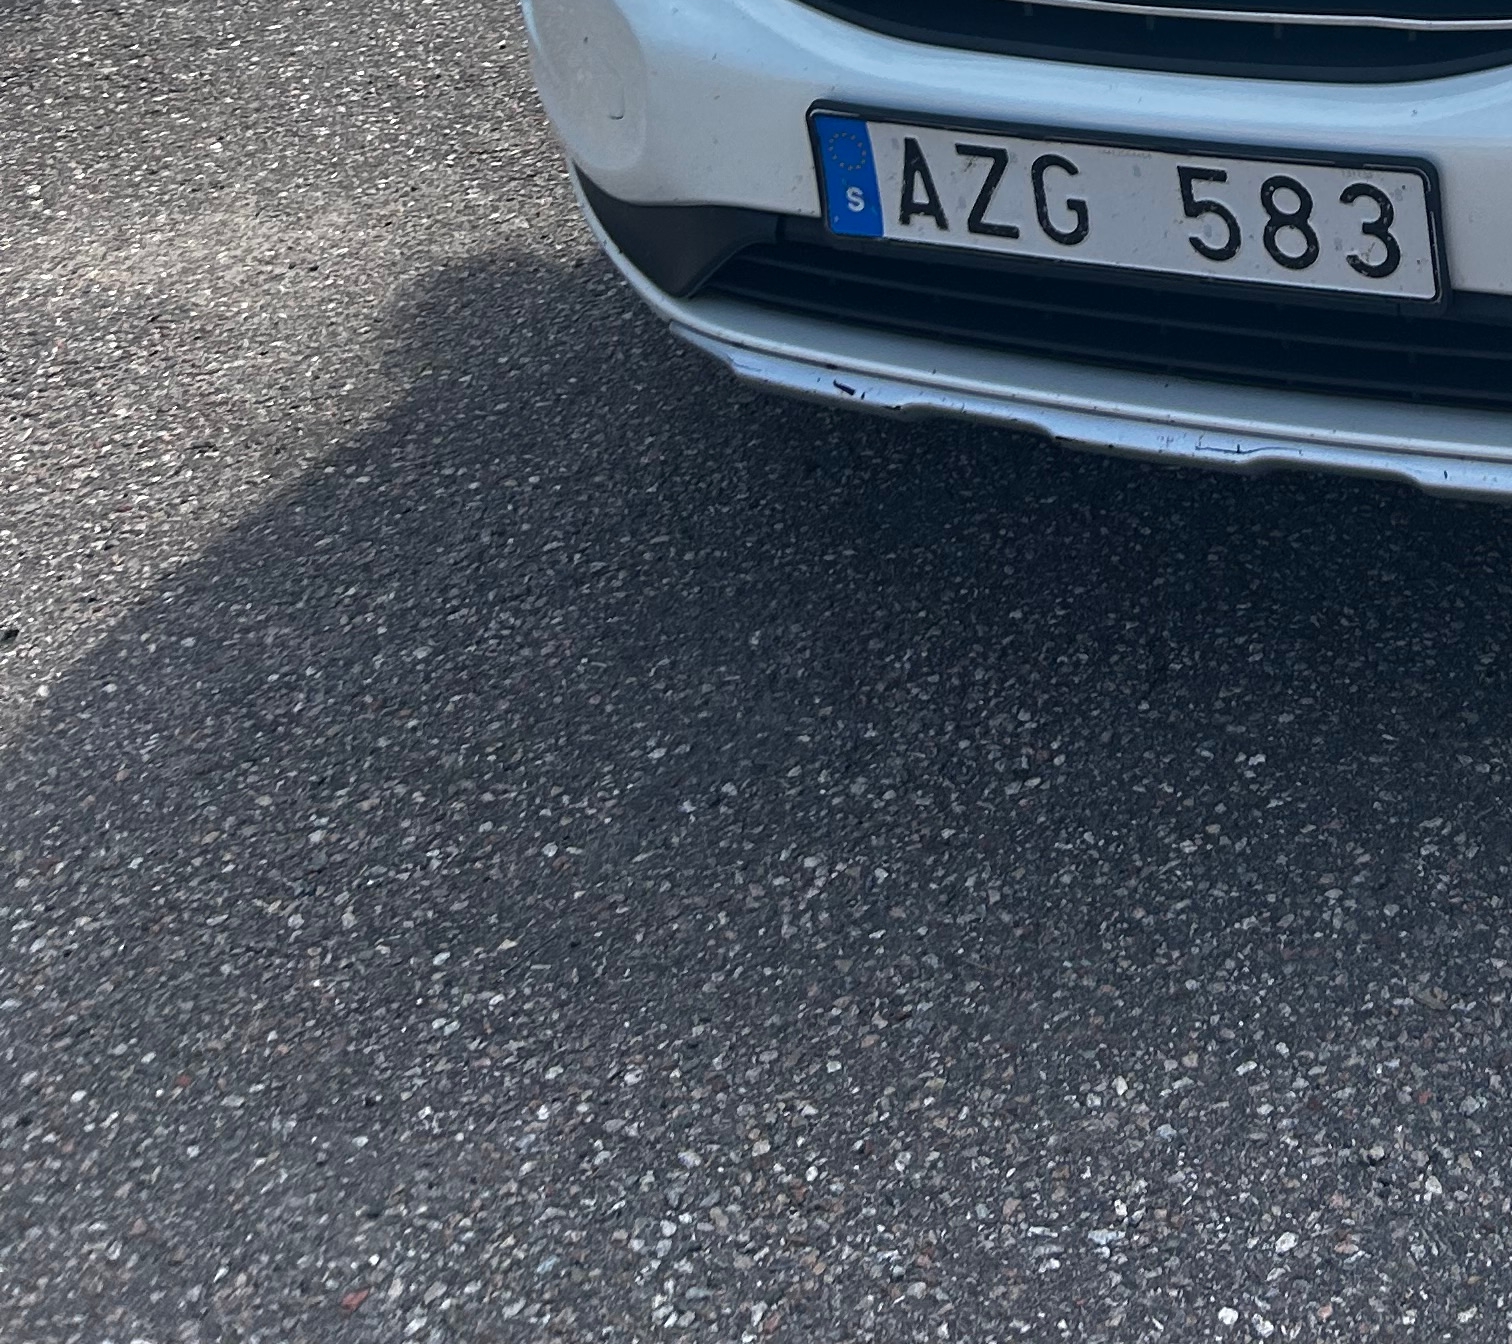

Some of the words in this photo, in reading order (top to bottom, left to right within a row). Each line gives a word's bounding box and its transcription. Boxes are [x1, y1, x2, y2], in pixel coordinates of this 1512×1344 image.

[846, 186, 865, 212] S
[899, 136, 1090, 246] AZG
[1177, 164, 1402, 280] 583
